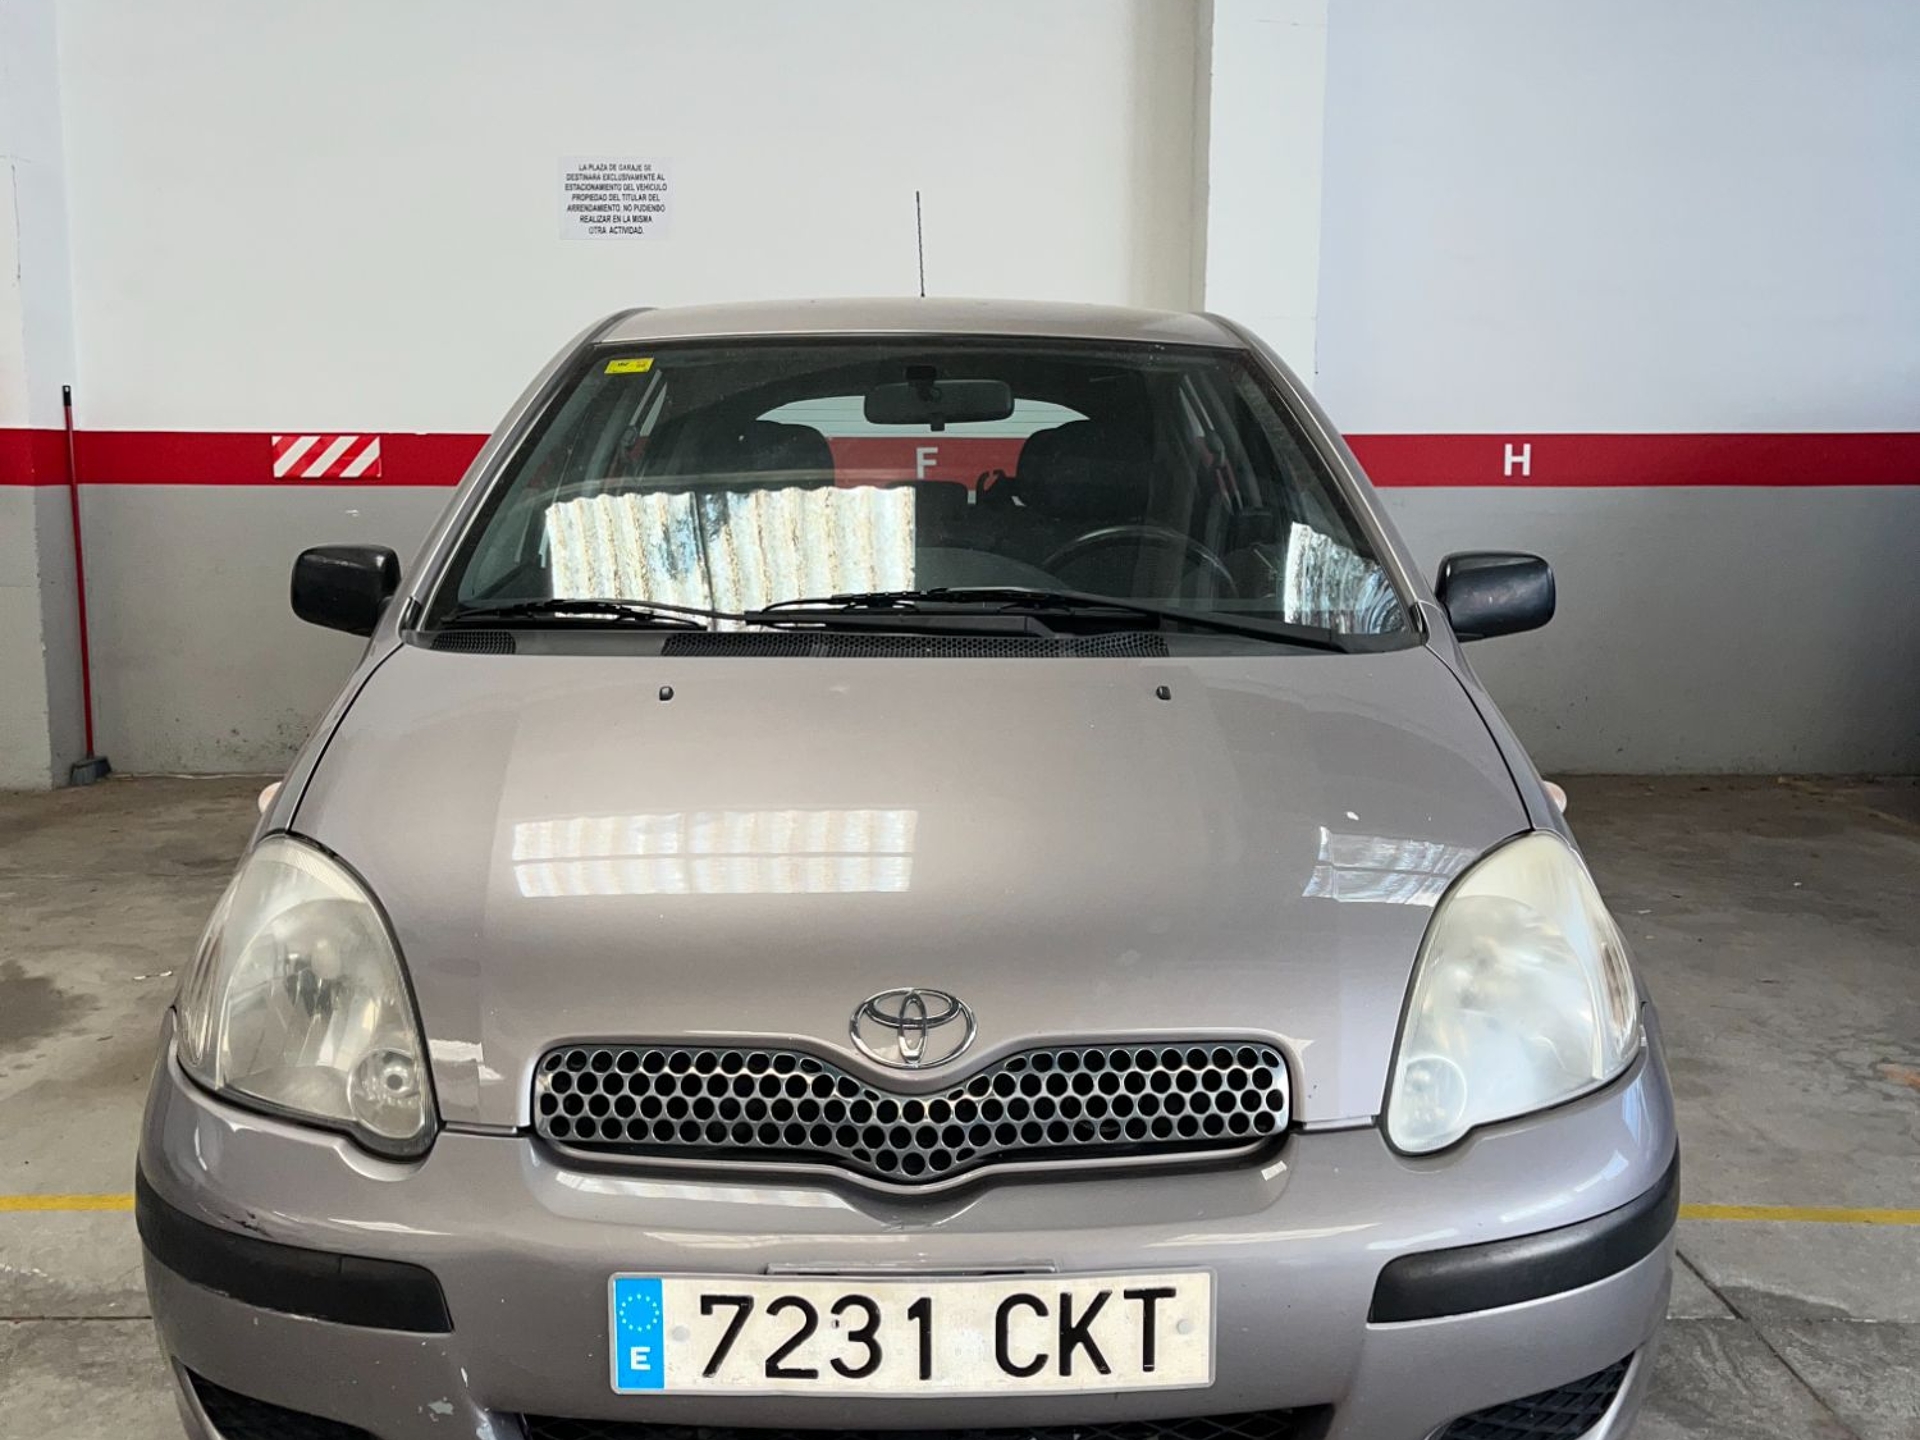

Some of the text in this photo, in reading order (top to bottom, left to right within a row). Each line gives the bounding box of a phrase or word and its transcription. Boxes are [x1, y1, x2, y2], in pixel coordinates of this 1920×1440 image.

[579, 163, 587, 171] LA
[588, 163, 607, 171] PLAZA
[609, 163, 617, 171] DE
[618, 163, 642, 171] GARAJE
[603, 173, 655, 181] EXCLUSIVAMENTE
[657, 173, 665, 181] AL
[565, 183, 622, 191] ESTACIONAMIENTO
[623, 183, 635, 191] DEL
[572, 193, 660, 201] PROPIEDAD DEL TITULAR DEL
[623, 203, 632, 212] NO
[634, 203, 666, 212] PUDIENDO
[580, 214, 652, 223] REALIZAR EN LA MISMA
[588, 226, 607, 235] OTRA
[916, 446, 939, 480] F
[1504, 443, 1531, 476] H
[700, 1286, 1177, 1381] 7231 CKT
[630, 1346, 651, 1371] E
